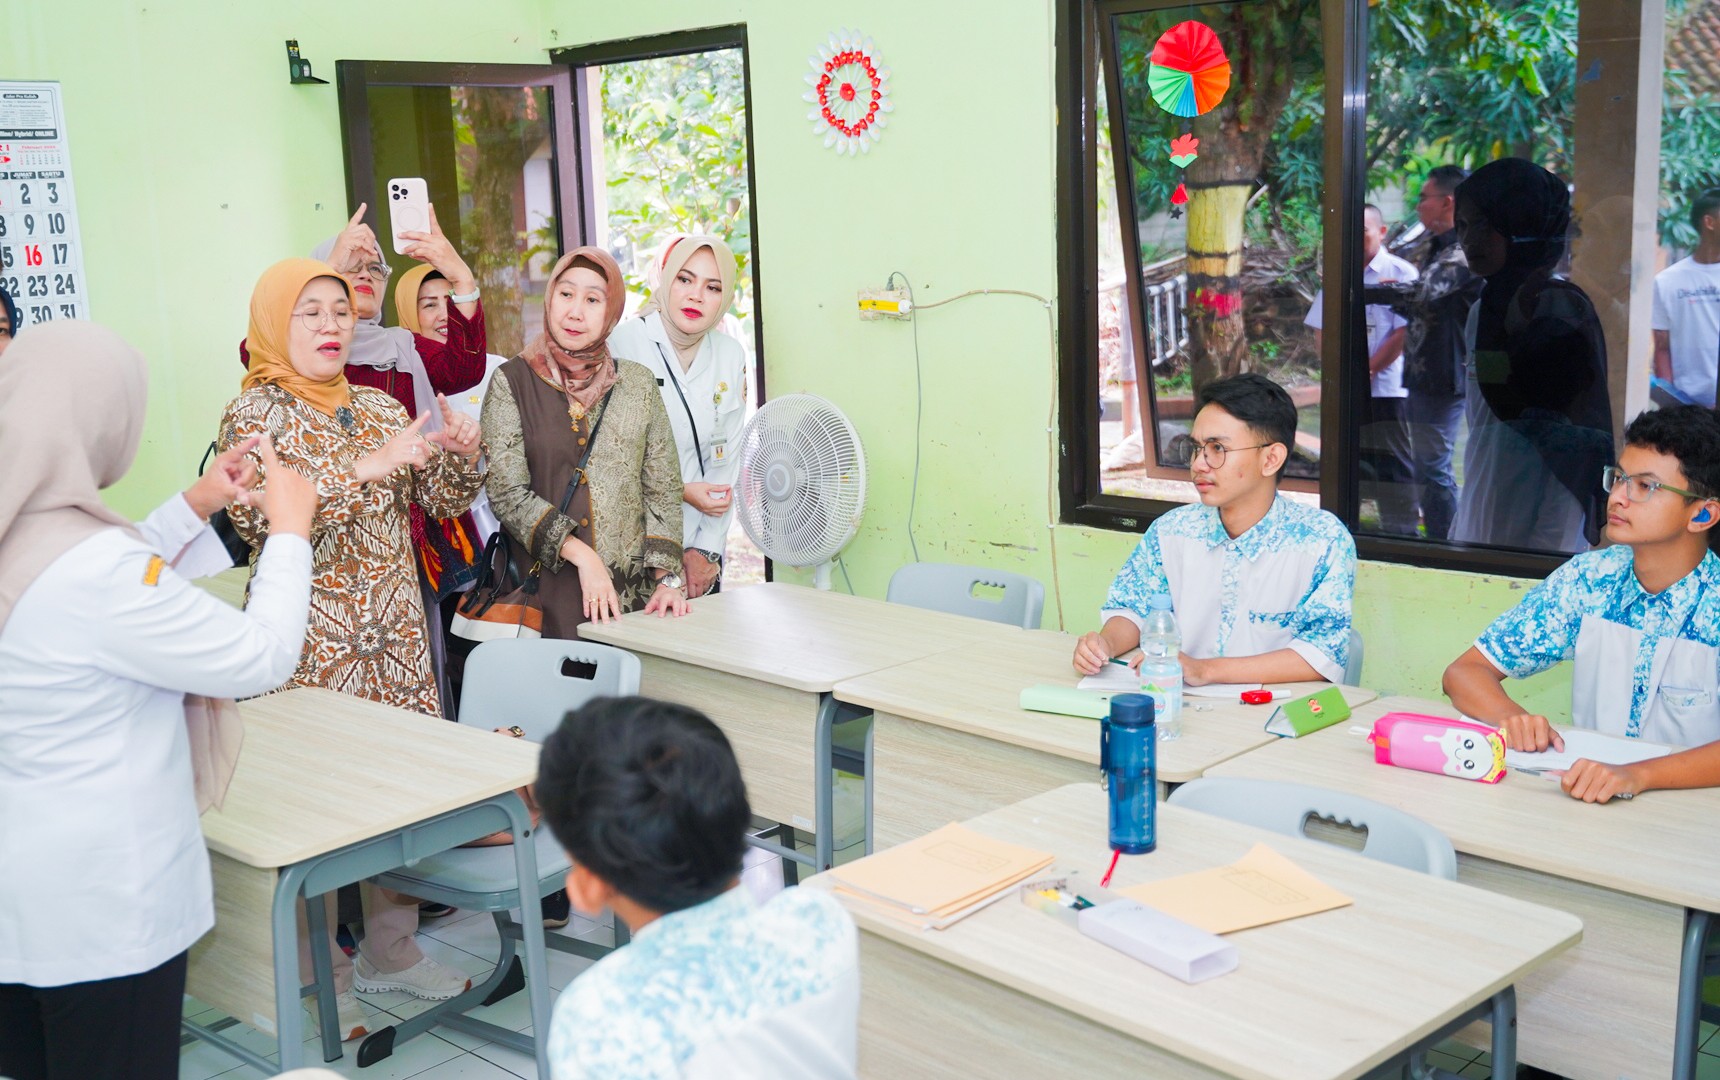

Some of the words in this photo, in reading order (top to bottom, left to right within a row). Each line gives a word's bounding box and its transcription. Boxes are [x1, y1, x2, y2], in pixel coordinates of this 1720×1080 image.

[20, 183, 31, 204] 2
[47, 182, 58, 204] 3
[24, 214, 34, 235] 9
[48, 212, 65, 234] 10
[25, 244, 42, 266] 16
[52, 244, 68, 264] 17
[28, 276, 48, 296] 23
[54, 274, 76, 294] 24
[31, 306, 52, 325] 30
[60, 304, 76, 320] 31
